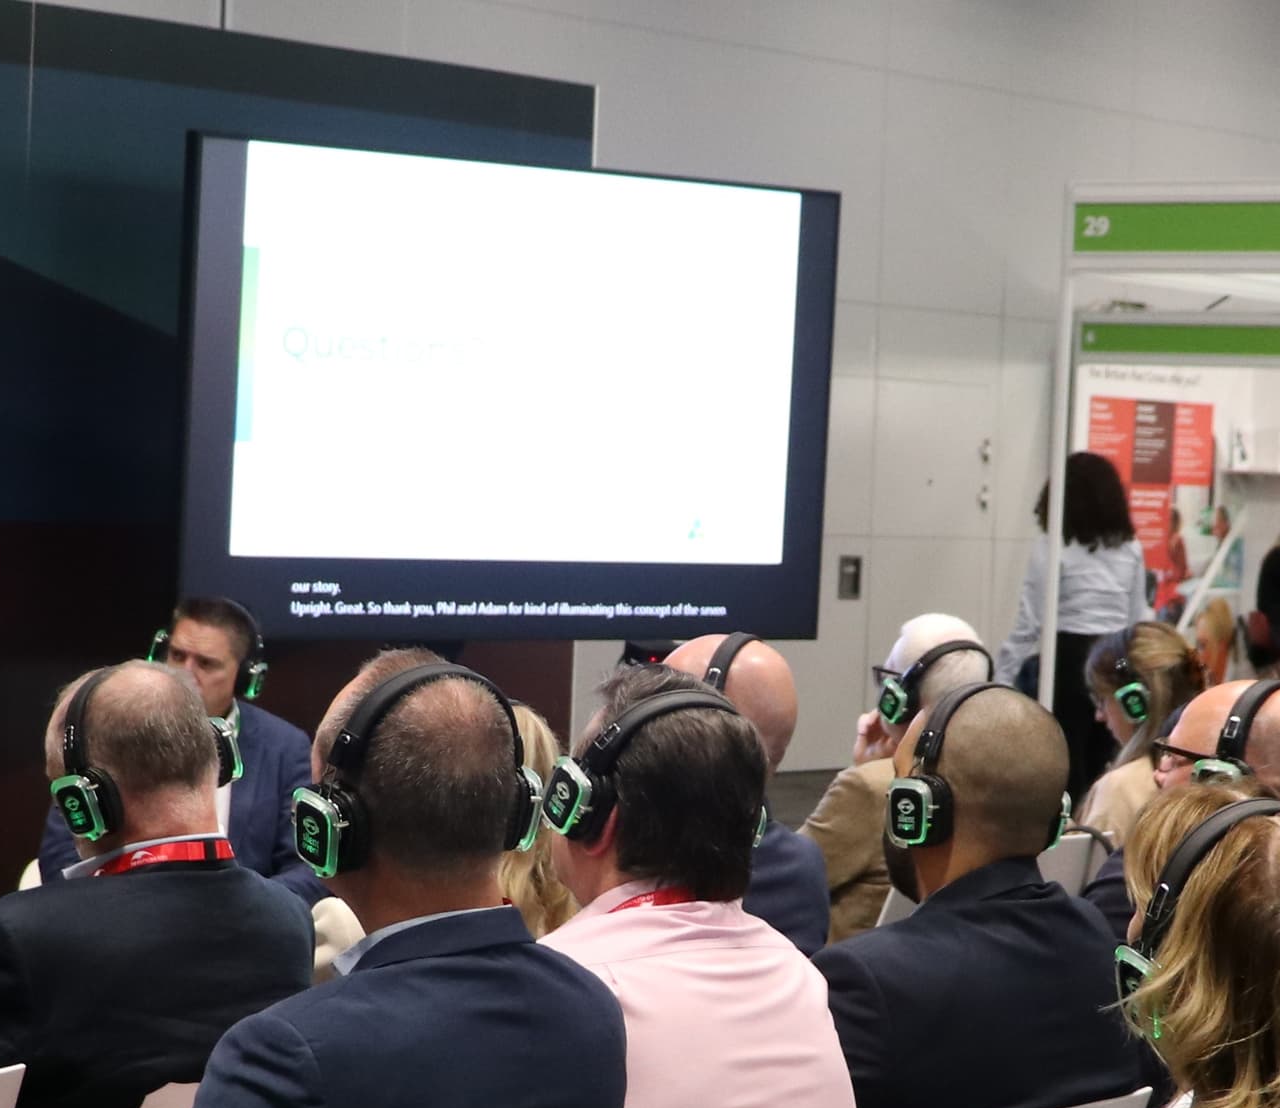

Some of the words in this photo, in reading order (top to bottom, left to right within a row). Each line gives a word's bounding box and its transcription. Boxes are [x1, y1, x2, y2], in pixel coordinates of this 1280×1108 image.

[1082, 215, 1109, 238] 29
[291, 582, 310, 594] our
[312, 581, 342, 596] story.
[291, 601, 333, 618] Upright.
[335, 601, 366, 615] Great.
[368, 601, 382, 615] So
[383, 601, 411, 615] thank
[436, 601, 456, 615] Phil
[457, 602, 476, 616] and
[478, 602, 507, 616] Adam
[508, 601, 523, 615] for
[524, 601, 546, 616] kind
[547, 602, 559, 616] of
[559, 601, 614, 619] illuminating
[615, 602, 632, 617] this
[634, 603, 670, 619] concept
[671, 602, 683, 617] of
[684, 603, 699, 617] the
